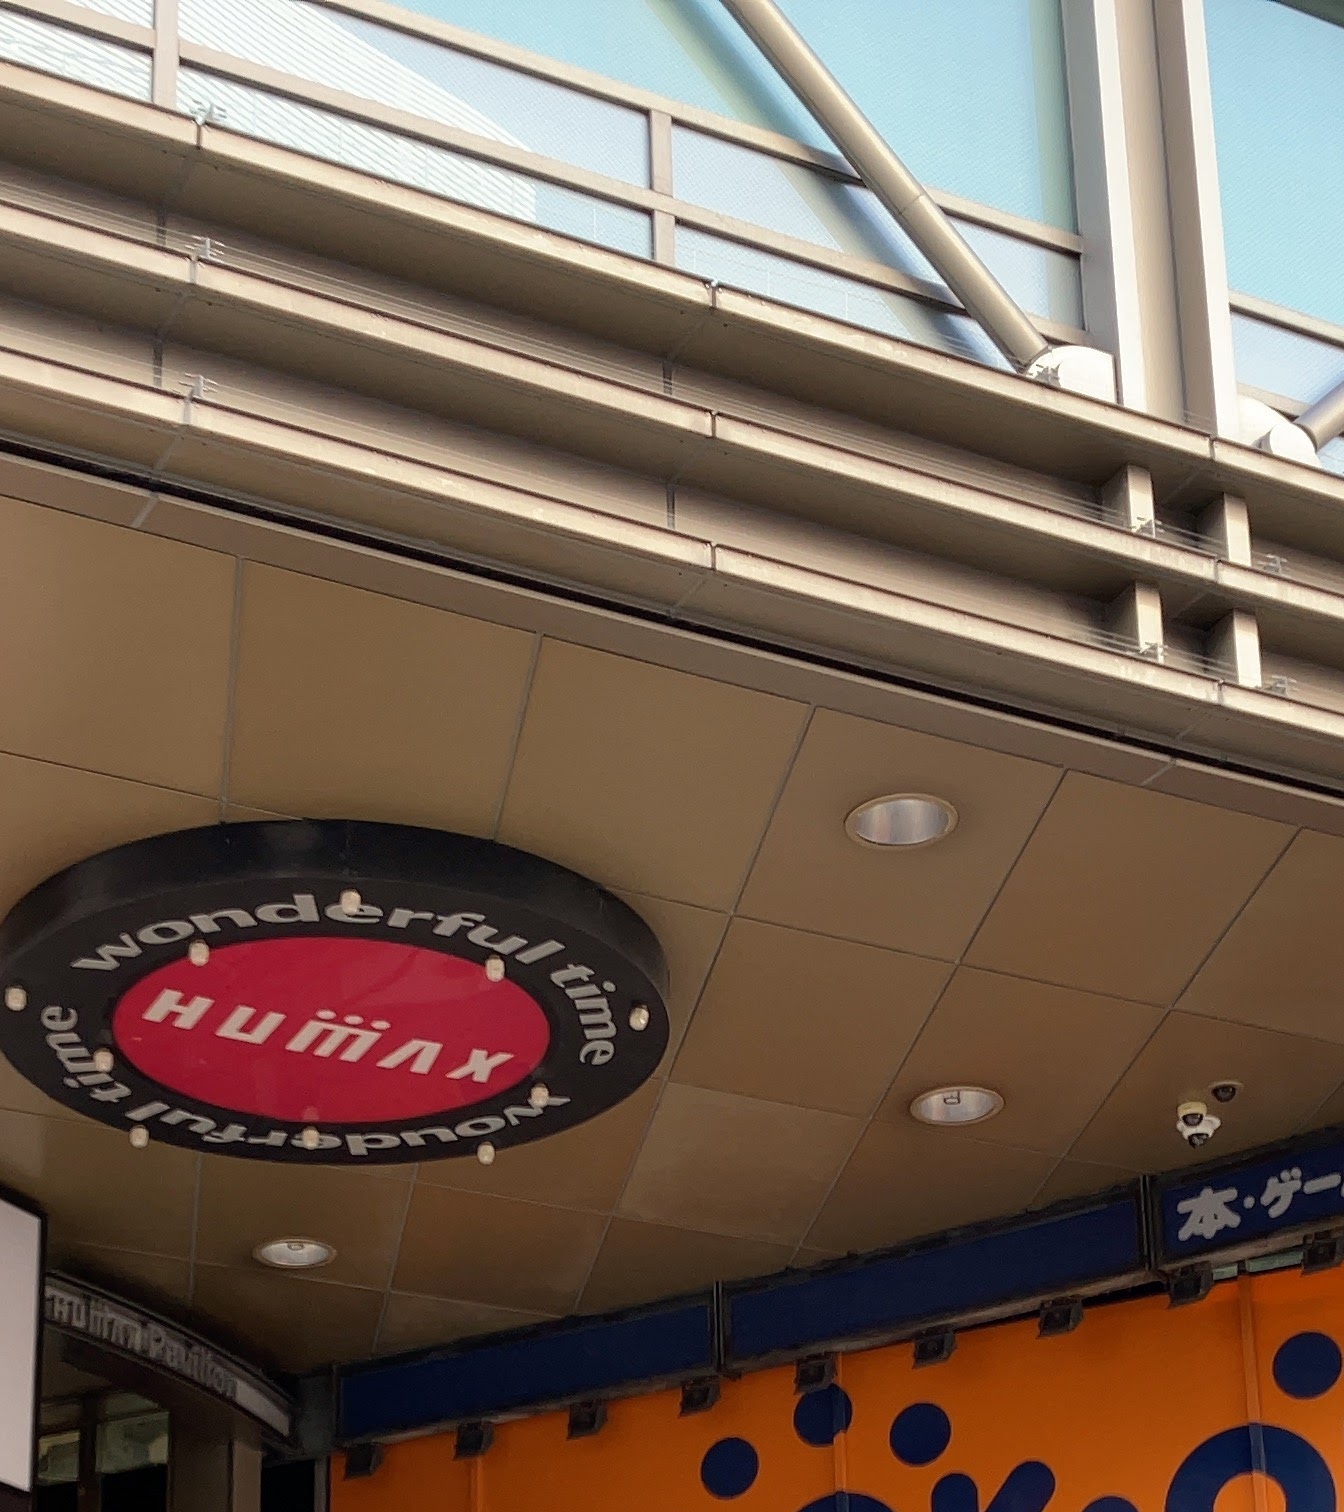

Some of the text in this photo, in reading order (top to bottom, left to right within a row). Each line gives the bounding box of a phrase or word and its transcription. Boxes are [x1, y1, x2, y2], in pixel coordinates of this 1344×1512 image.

[69, 893, 618, 1067] wonderful time
[40, 1004, 133, 1105] time
[142, 985, 513, 1083] HUMAX
